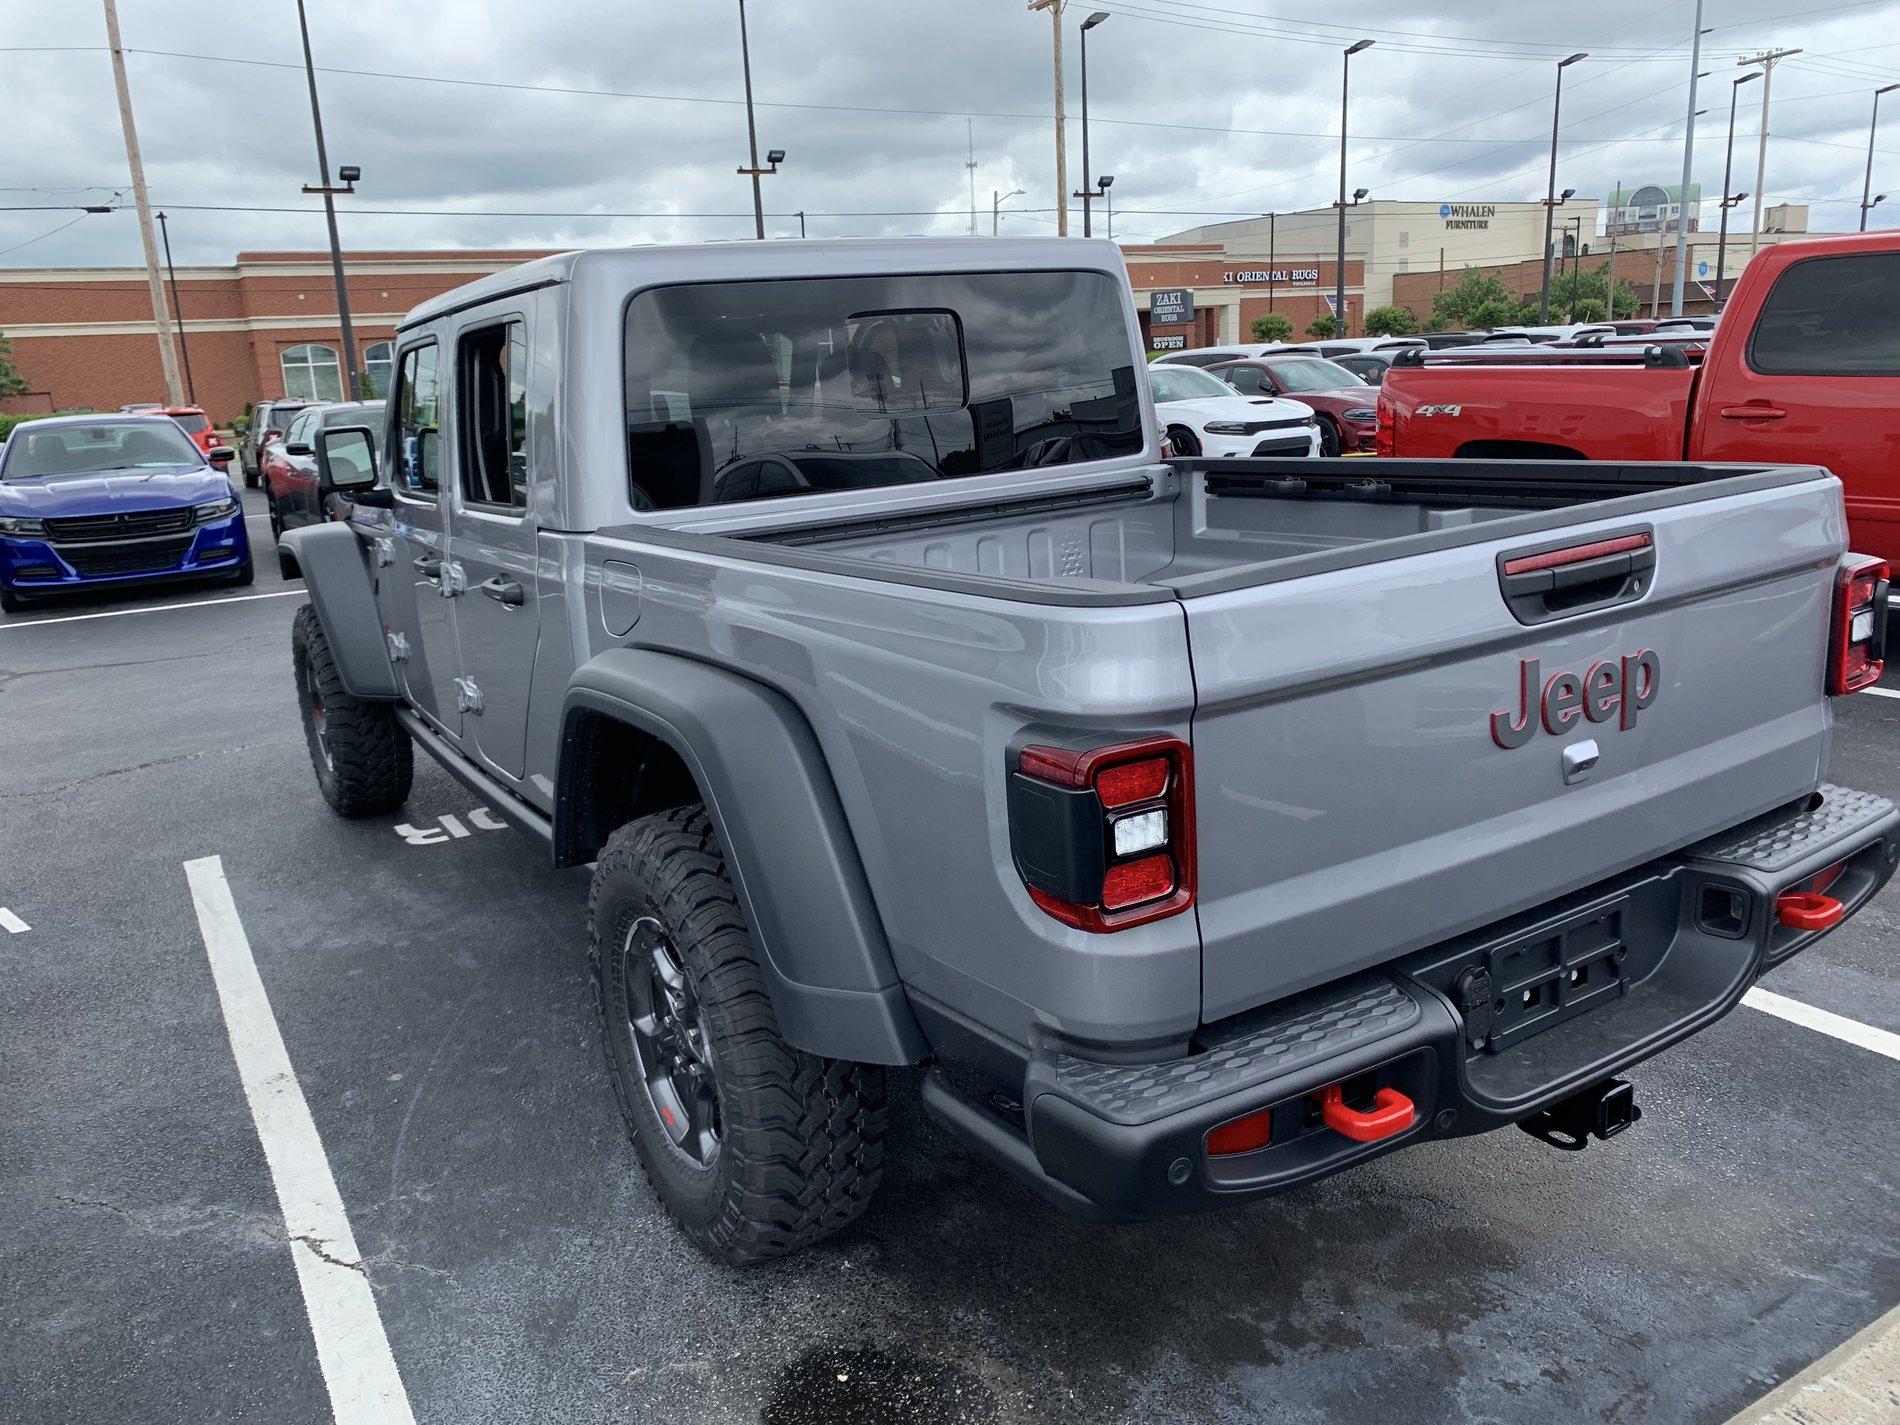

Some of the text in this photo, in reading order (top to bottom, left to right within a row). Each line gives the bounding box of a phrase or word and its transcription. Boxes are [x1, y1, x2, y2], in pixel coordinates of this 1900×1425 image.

[1450, 205, 1495, 217] WHALEN
[1445, 220, 1489, 230] FURNITURE
[1236, 271, 1289, 282] ORIENTAL
[1291, 269, 1318, 280] RUGS
[1156, 292, 1182, 306] ZAKI
[1153, 305, 1184, 314] ORIENTAL
[1161, 313, 1178, 322] RUGS
[1153, 341, 1184, 349] OPEN
[1490, 648, 1661, 749] Jeep
